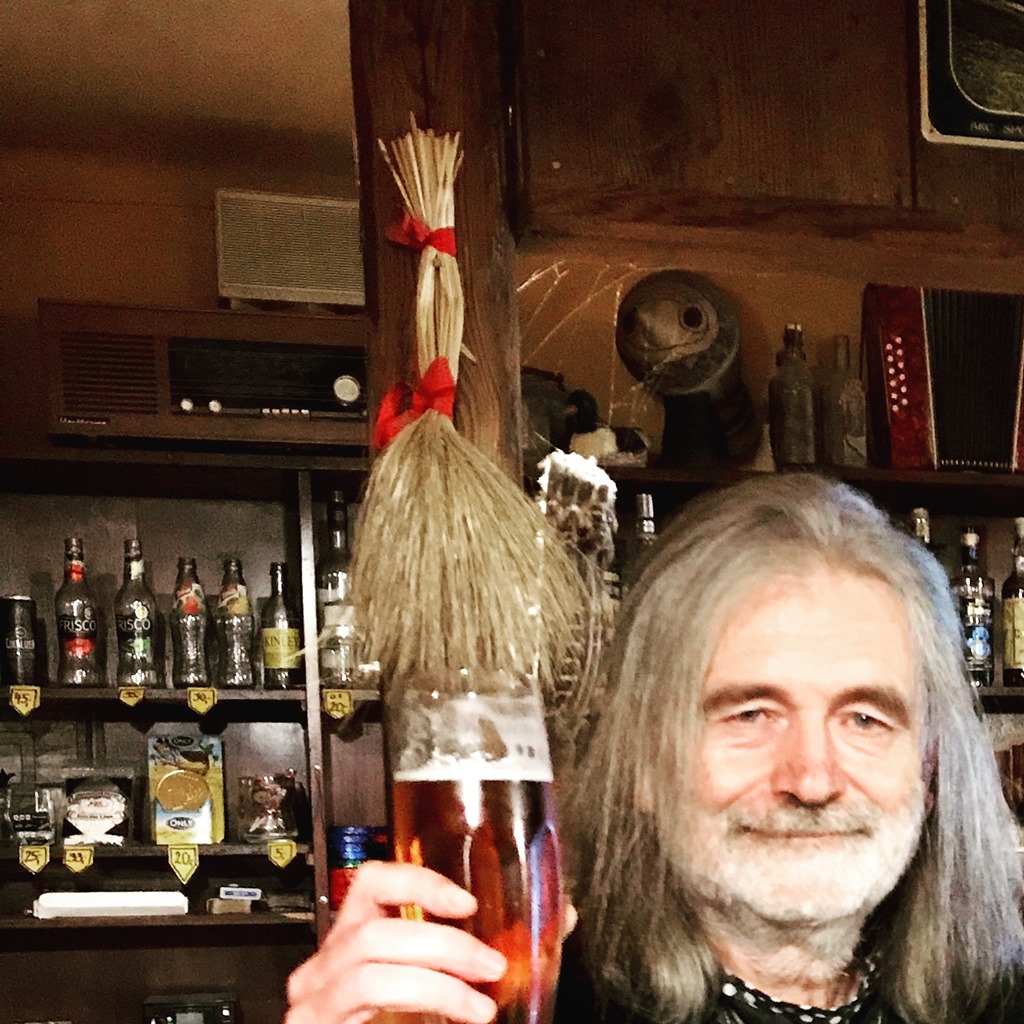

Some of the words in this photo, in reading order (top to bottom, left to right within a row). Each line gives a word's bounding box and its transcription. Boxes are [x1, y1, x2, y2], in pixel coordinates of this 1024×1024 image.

[60, 619, 97, 632] FRISCO
[117, 618, 151, 632] RISCO
[170, 818, 194, 828] ONLY
